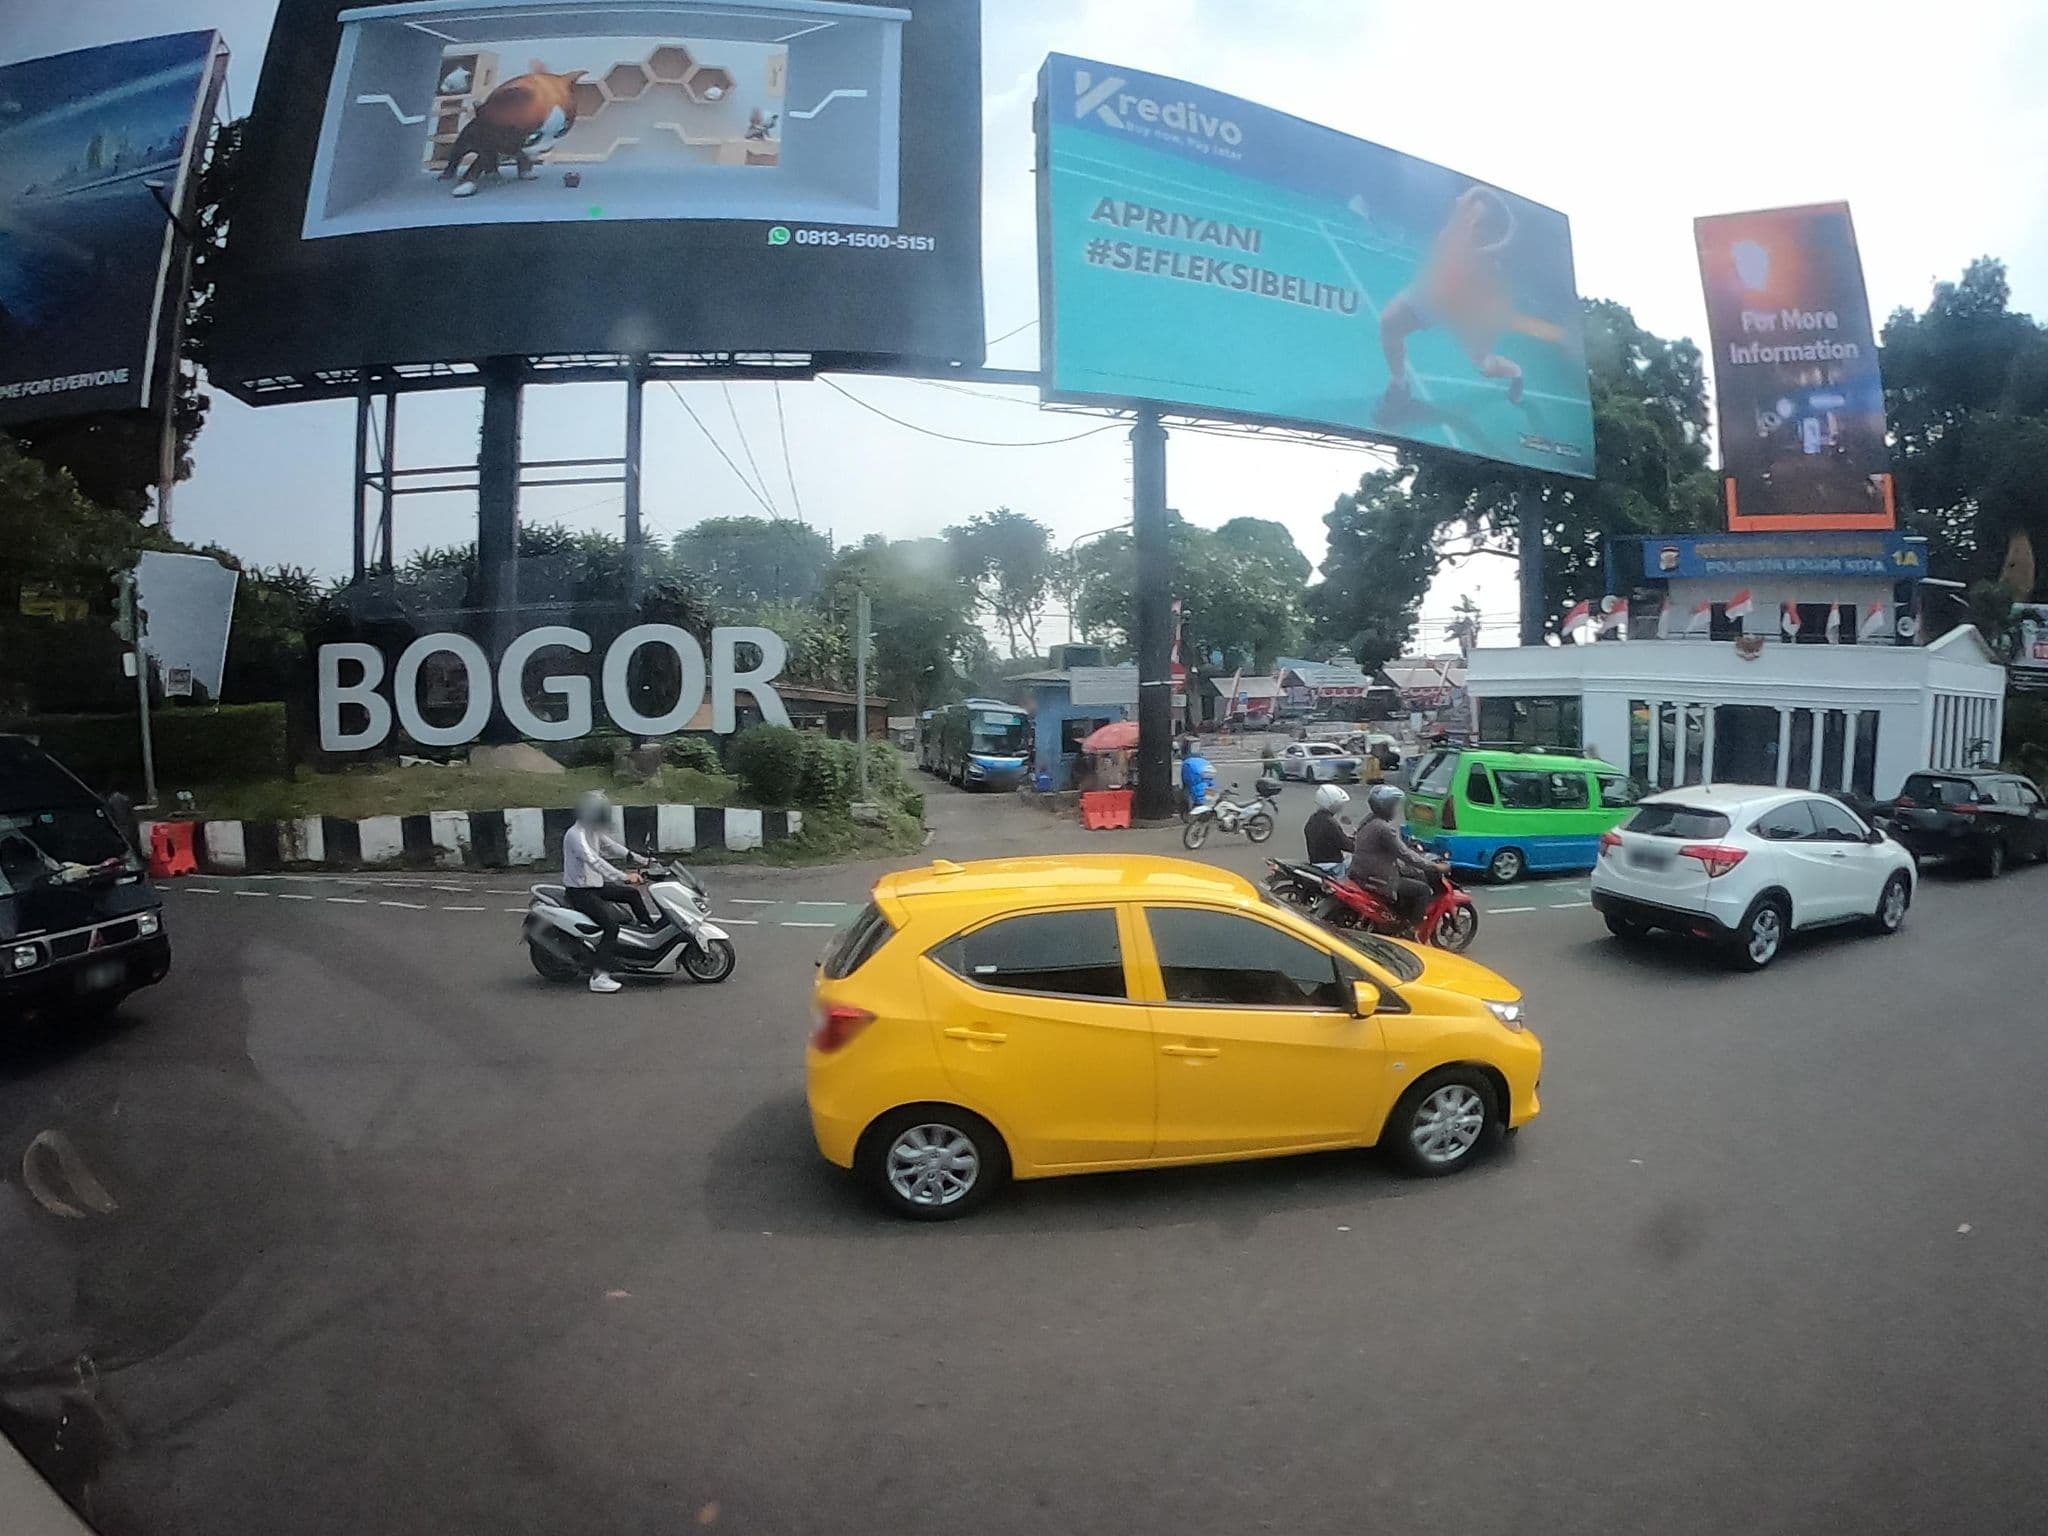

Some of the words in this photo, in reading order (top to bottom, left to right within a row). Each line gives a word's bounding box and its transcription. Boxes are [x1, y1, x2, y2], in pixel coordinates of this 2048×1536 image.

[1073, 70, 1243, 146] Kredivo
[794, 229, 936, 251] 0813-1500-5151
[1090, 197, 1264, 254] APRIYANI
[1085, 238, 1361, 316] #SEFLEKSIBELITU
[1741, 310, 1776, 332] For
[1782, 308, 1839, 331] More
[1730, 340, 1859, 365] Information
[22, 379, 51, 397] FOR
[52, 368, 130, 392] EVERYONE
[317, 623, 793, 752] BOGOR
